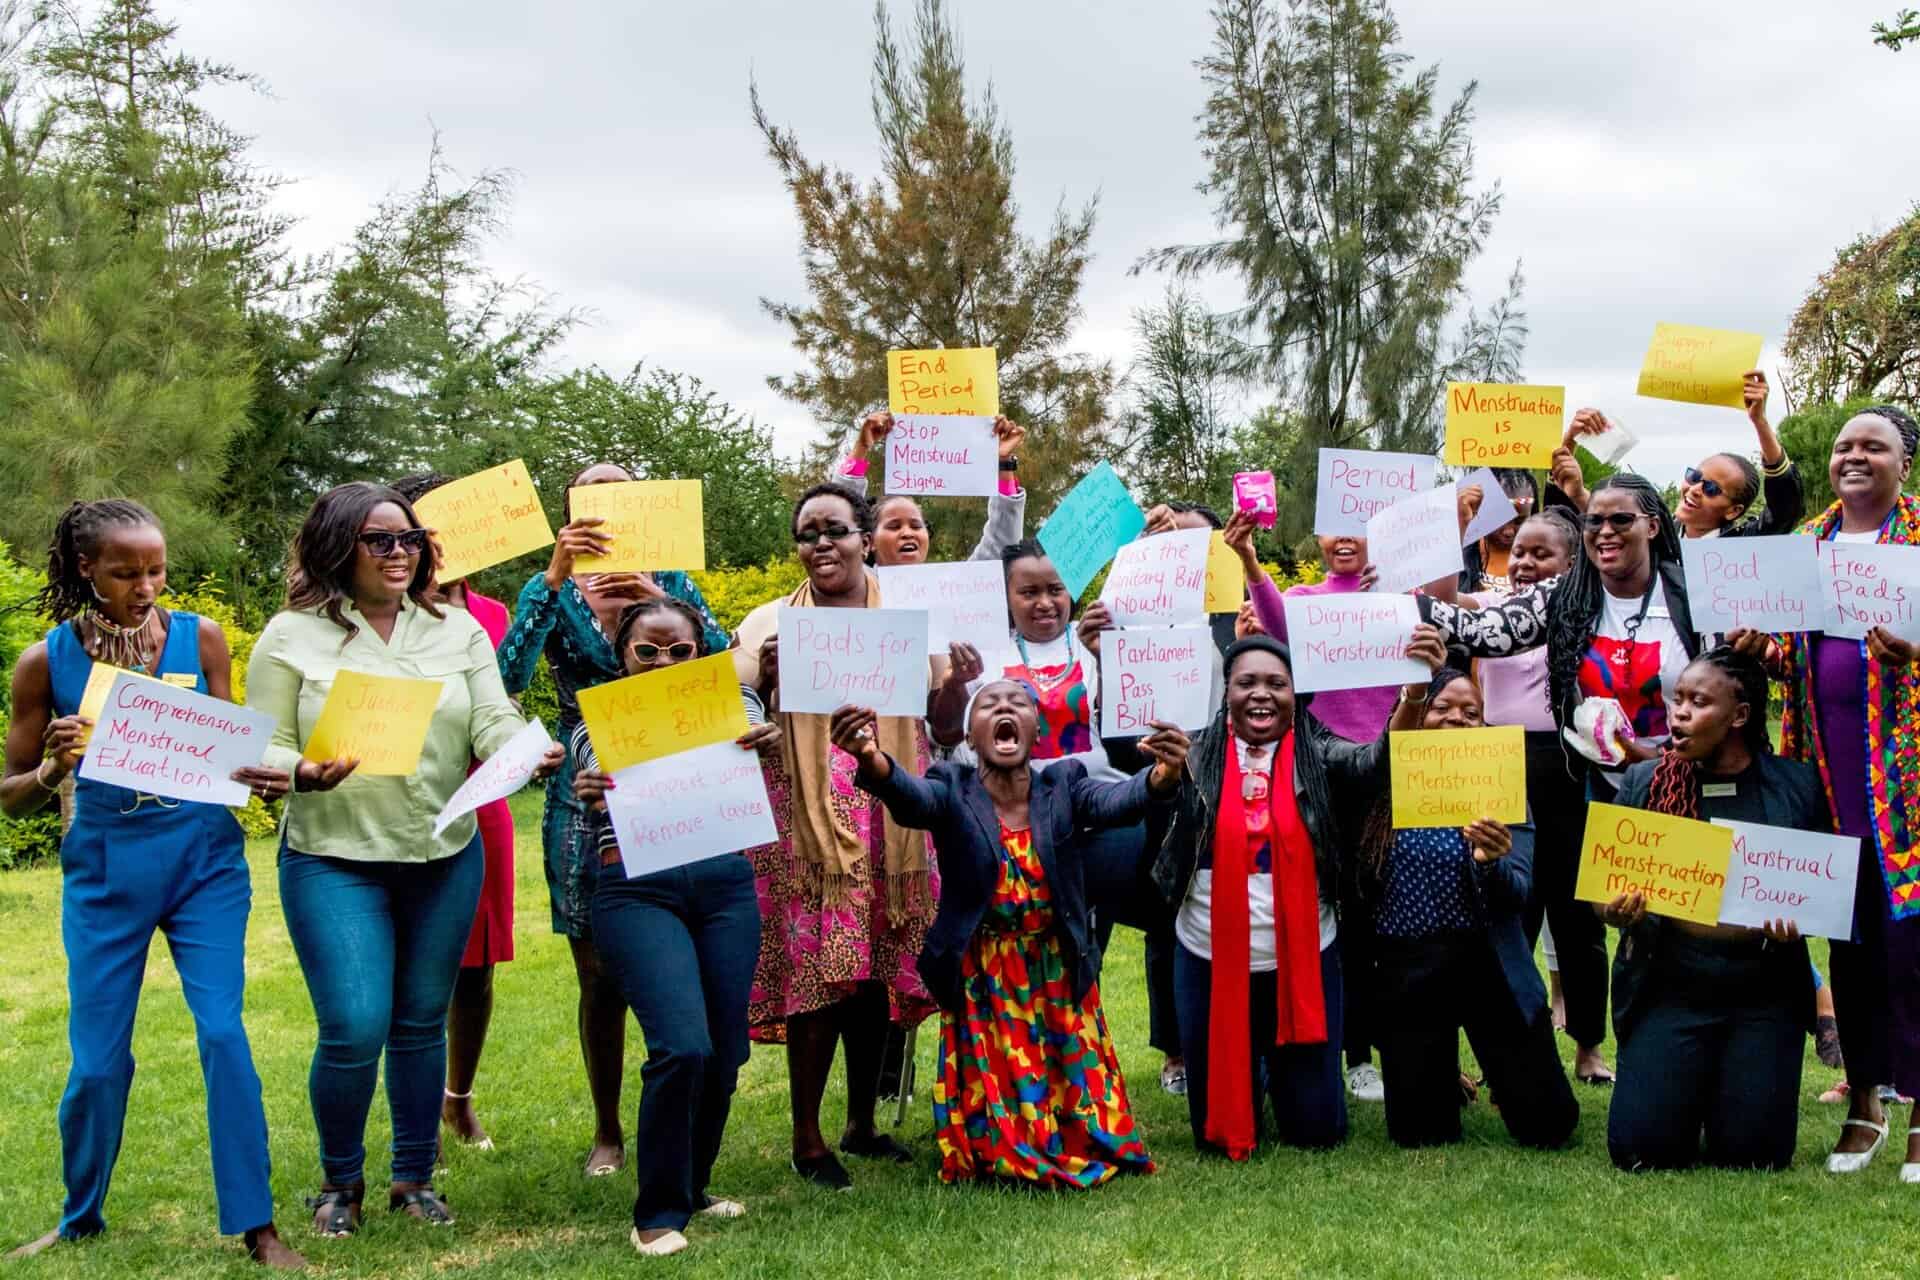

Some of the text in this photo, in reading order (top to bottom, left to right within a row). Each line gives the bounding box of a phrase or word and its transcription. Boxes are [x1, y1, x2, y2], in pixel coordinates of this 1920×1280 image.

[900, 356, 947, 376] End
[899, 378, 974, 401] Period
[1455, 387, 1562, 415] Menstruation
[895, 420, 940, 441] Stop
[894, 443, 973, 464] Menstrual
[1461, 438, 1531, 464] Power
[891, 469, 946, 492] Stigma
[1330, 459, 1417, 492] Period
[1702, 551, 1760, 584] Pad
[1830, 548, 1878, 579] Free
[1711, 585, 1808, 626] Equality
[1832, 578, 1906, 602] Pads
[794, 619, 917, 668] Pads for
[1118, 638, 1196, 667] Parliament
[599, 668, 721, 721] We need
[811, 659, 896, 707] Dignity
[1120, 668, 1200, 702] Pass THE
[117, 682, 252, 736] Comprehensive
[109, 719, 217, 763] Menstrual
[609, 726, 651, 750] the
[1407, 764, 1504, 790] Menstrual
[1615, 818, 1668, 847] Our
[1592, 843, 1725, 889] Menstruation
[1732, 835, 1837, 881] Menstrual
[1606, 874, 1702, 913] Matters!
[1741, 875, 1810, 906] Power
